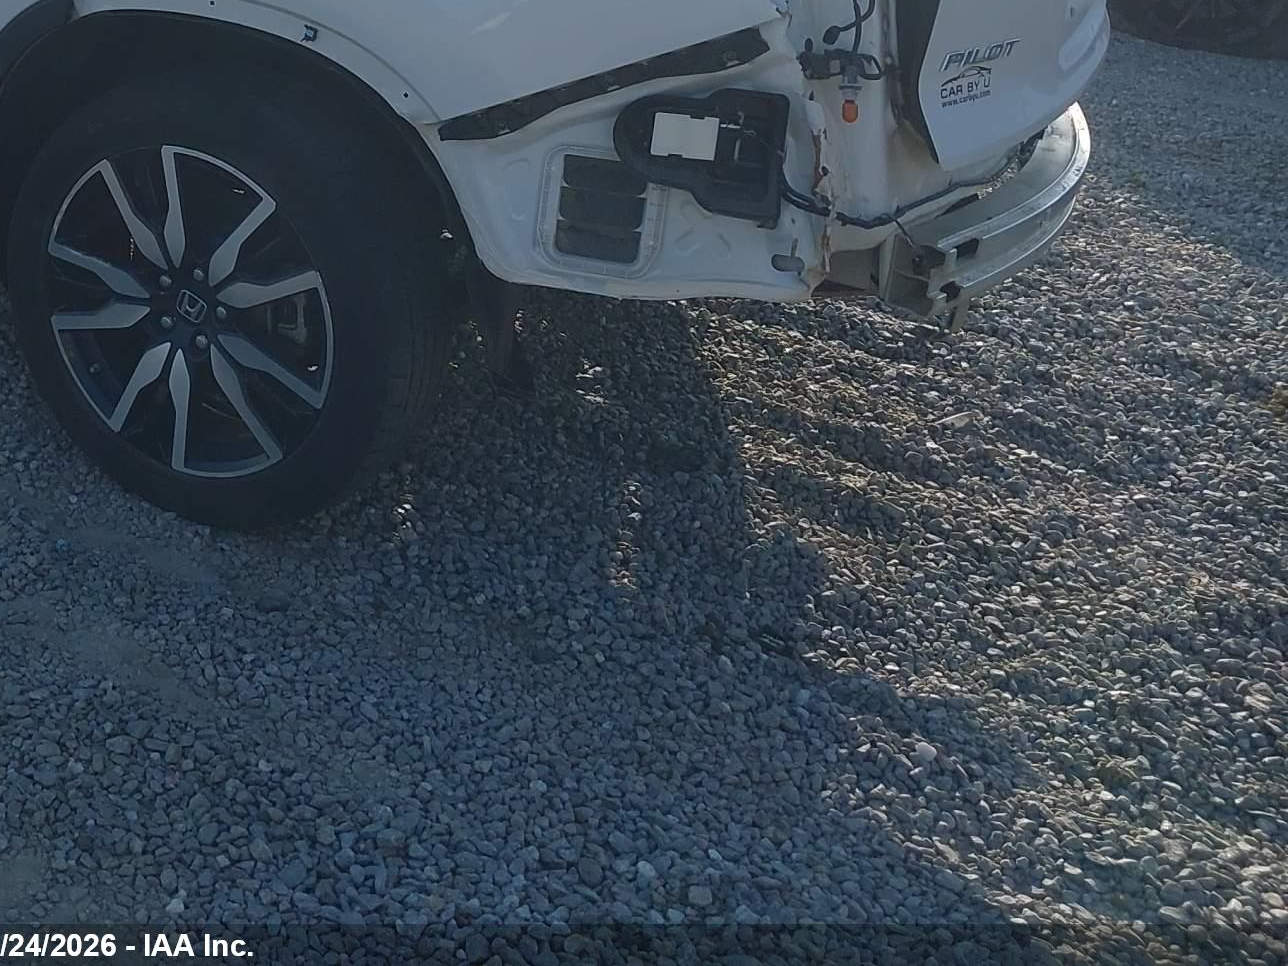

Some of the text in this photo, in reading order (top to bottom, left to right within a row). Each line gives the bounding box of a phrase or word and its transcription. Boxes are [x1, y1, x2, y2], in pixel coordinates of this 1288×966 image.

[940, 37, 1022, 72] PILOT
[940, 75, 991, 99] CAR BY U
